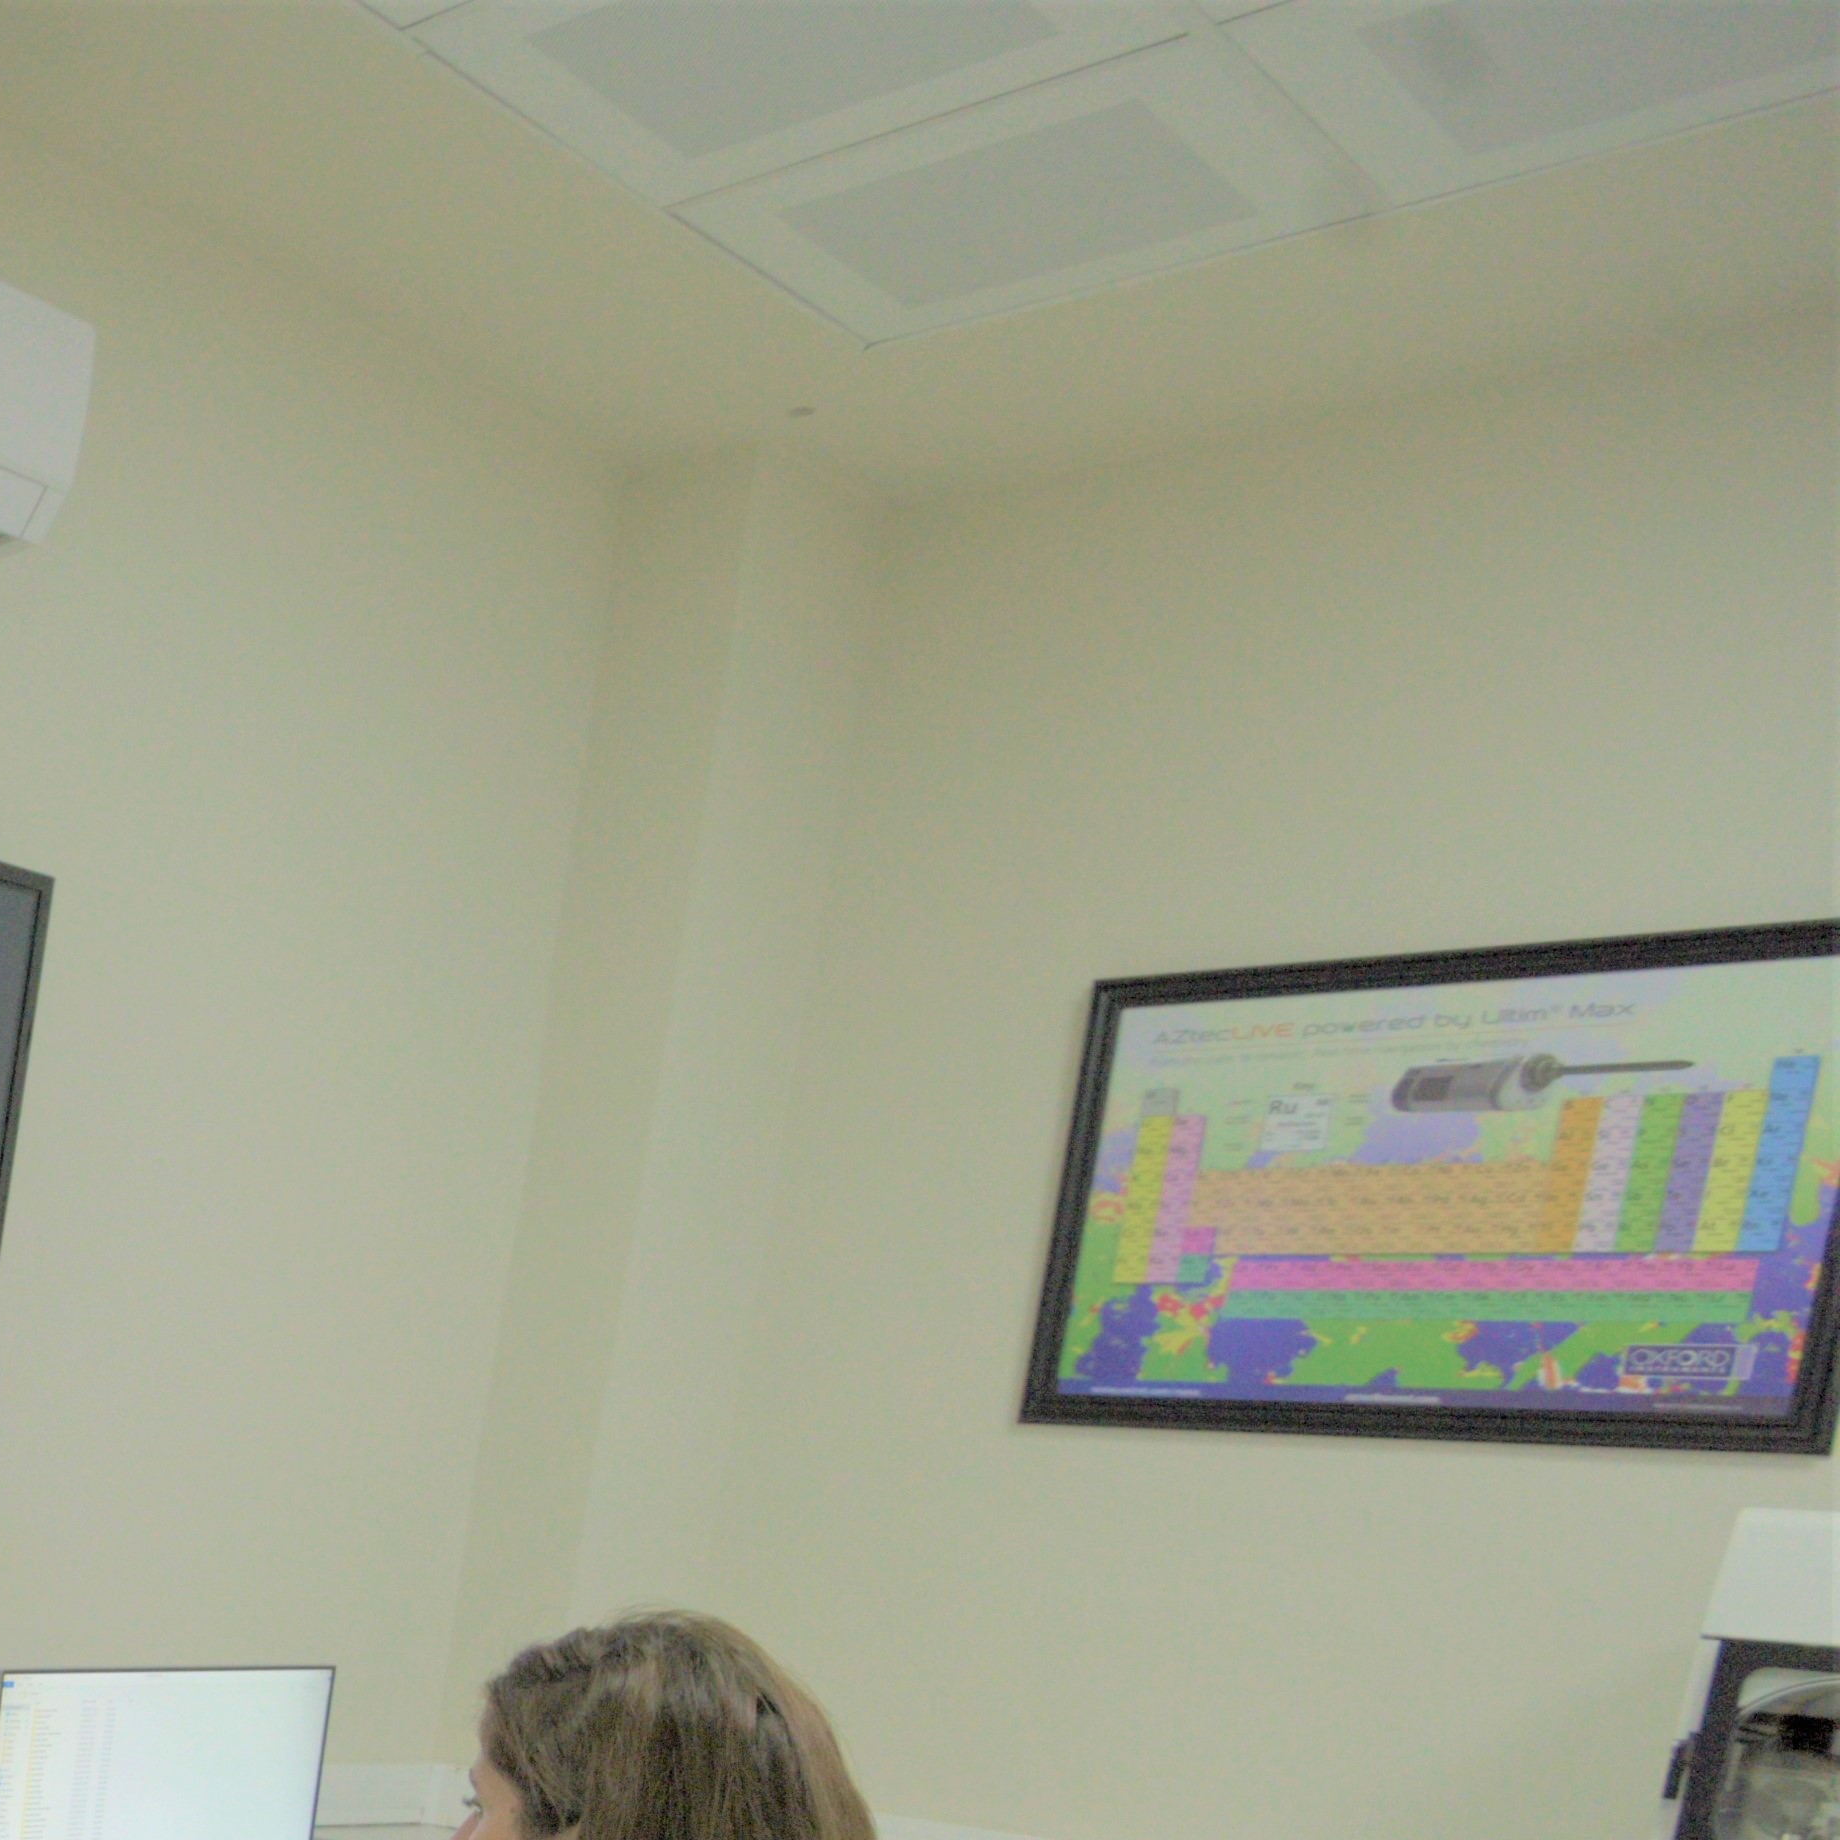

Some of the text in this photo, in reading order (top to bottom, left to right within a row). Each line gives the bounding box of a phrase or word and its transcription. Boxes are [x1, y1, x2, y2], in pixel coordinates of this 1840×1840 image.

[1301, 1013, 1427, 1039] powered
[1434, 1013, 1471, 1030] by
[1568, 1002, 1637, 1020] Max
[1629, 1349, 1732, 1367] OXFORD
